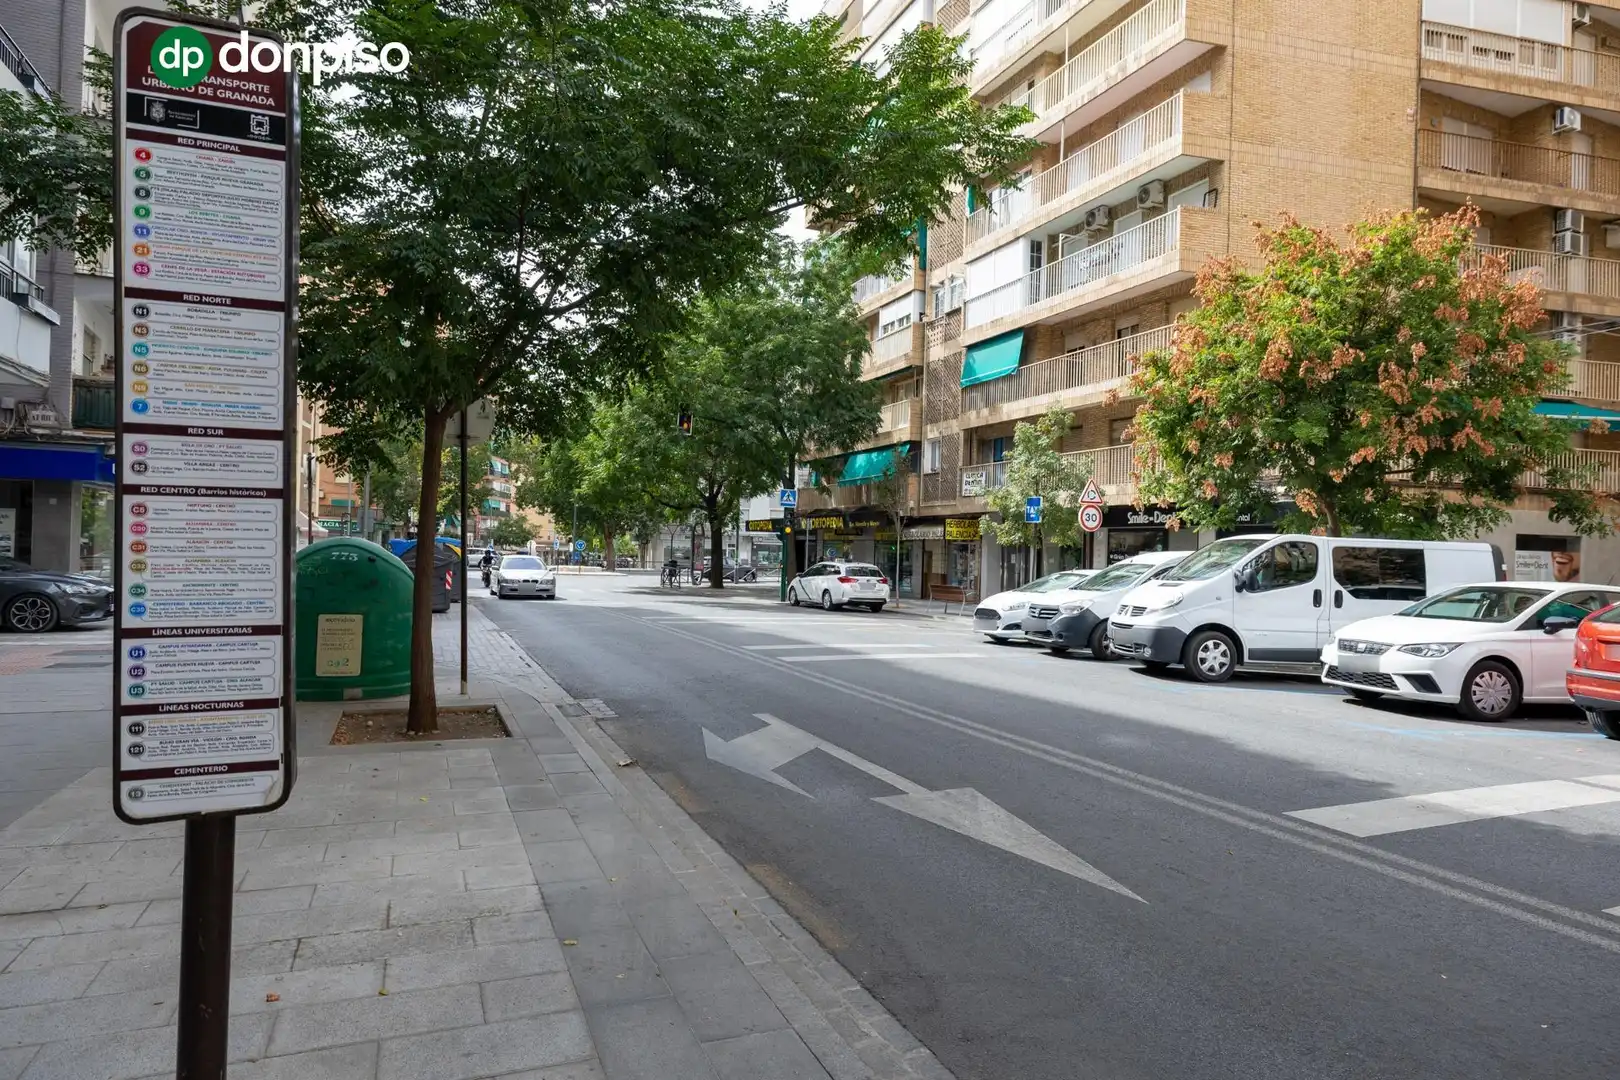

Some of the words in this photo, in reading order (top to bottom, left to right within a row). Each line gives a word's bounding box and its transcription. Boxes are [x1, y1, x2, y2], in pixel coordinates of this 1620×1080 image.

[201, 76, 270, 94] RANSPORTE
[198, 86, 214, 96] DE
[217, 89, 276, 106] GRANADA
[178, 137, 195, 146] RED
[197, 140, 240, 152] PRINCIPAL
[202, 296, 231, 304] NORTE
[1026, 506, 1038, 514] TAX
[1085, 513, 1098, 522] 30
[1236, 513, 1250, 522] ntal
[811, 517, 844, 529] ORTOPEDIA
[152, 628, 182, 636] LÍNEAS
[185, 627, 252, 635] UNIVERSITARIAS
[159, 703, 189, 712] LÍNEAS
[191, 701, 244, 710] NOCTURNAS
[174, 765, 228, 775] CEMENTERIO
